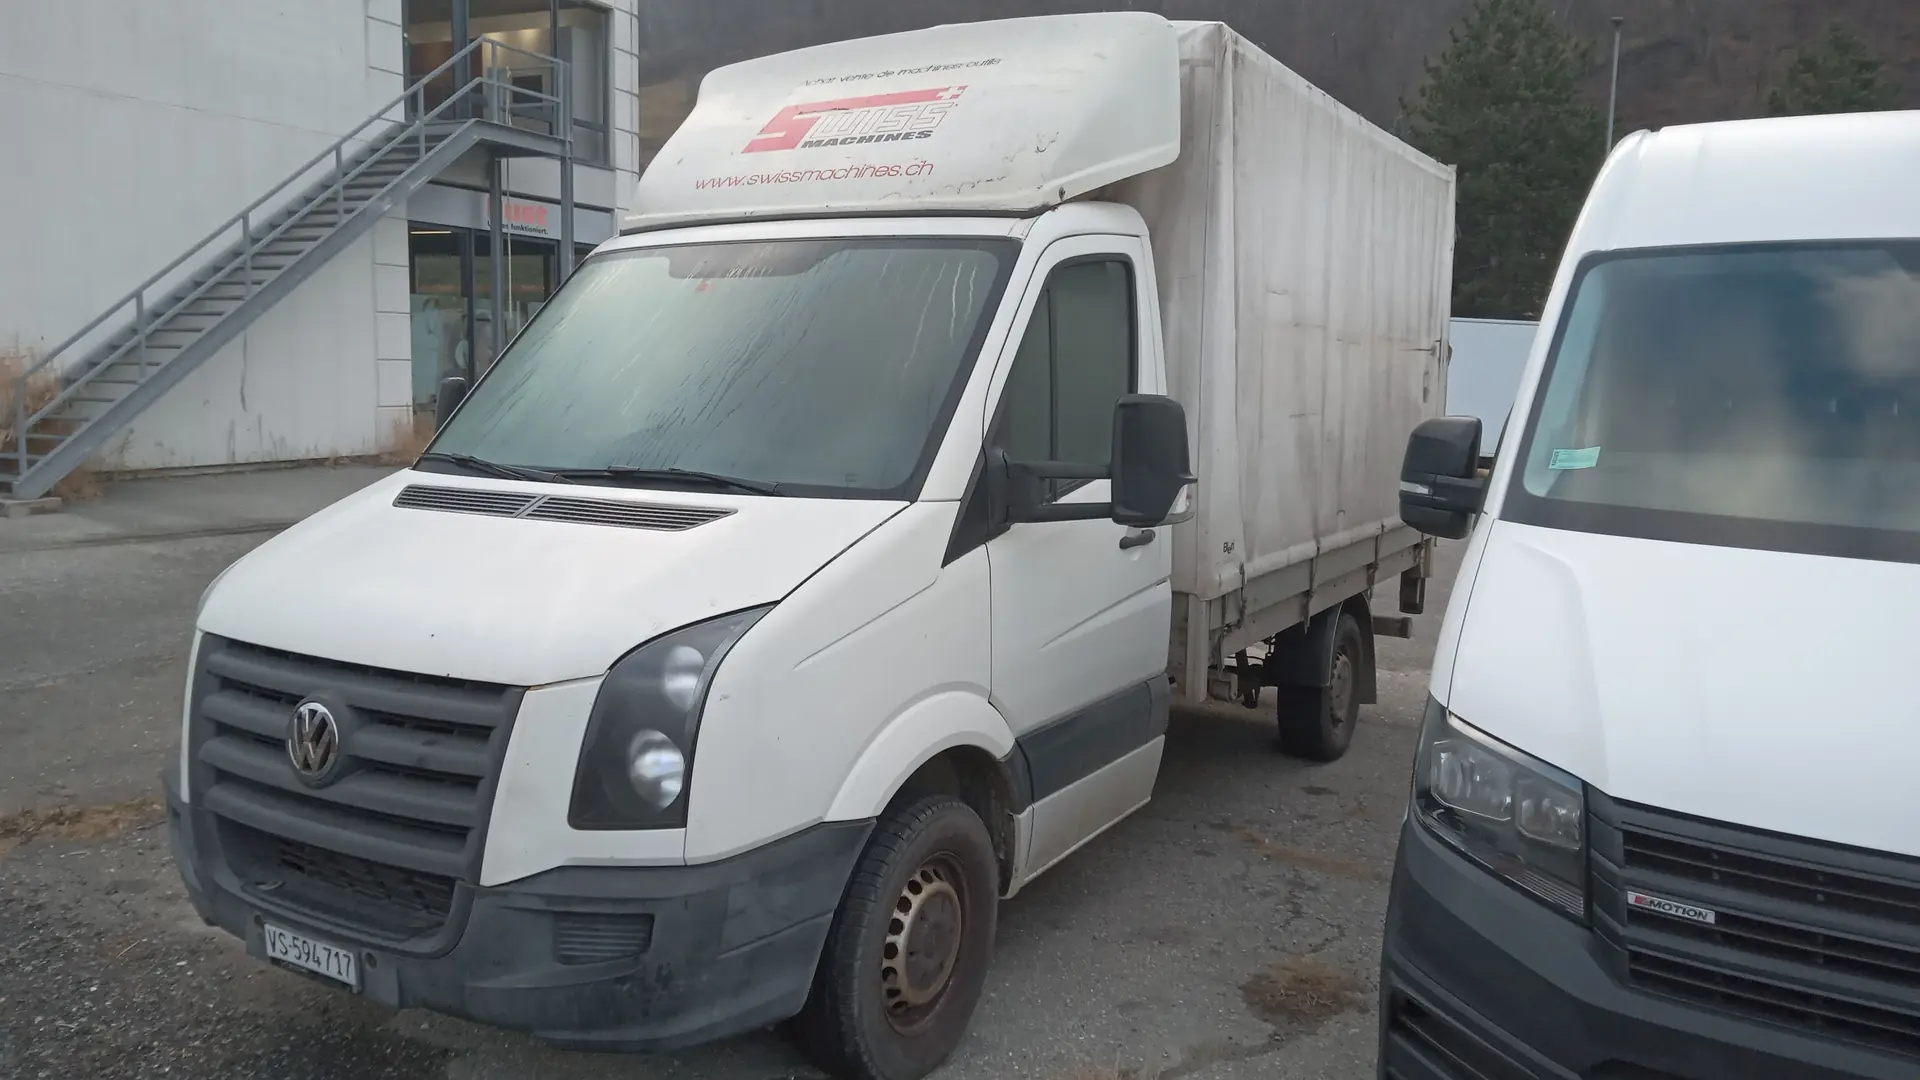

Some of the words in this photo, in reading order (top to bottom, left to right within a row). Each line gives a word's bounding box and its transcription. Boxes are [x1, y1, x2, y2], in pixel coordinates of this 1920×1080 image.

[876, 69, 895, 79] de
[800, 130, 934, 149] MACHINES
[695, 160, 935, 190] www.swissmachines.ch
[487, 197, 548, 226] ust
